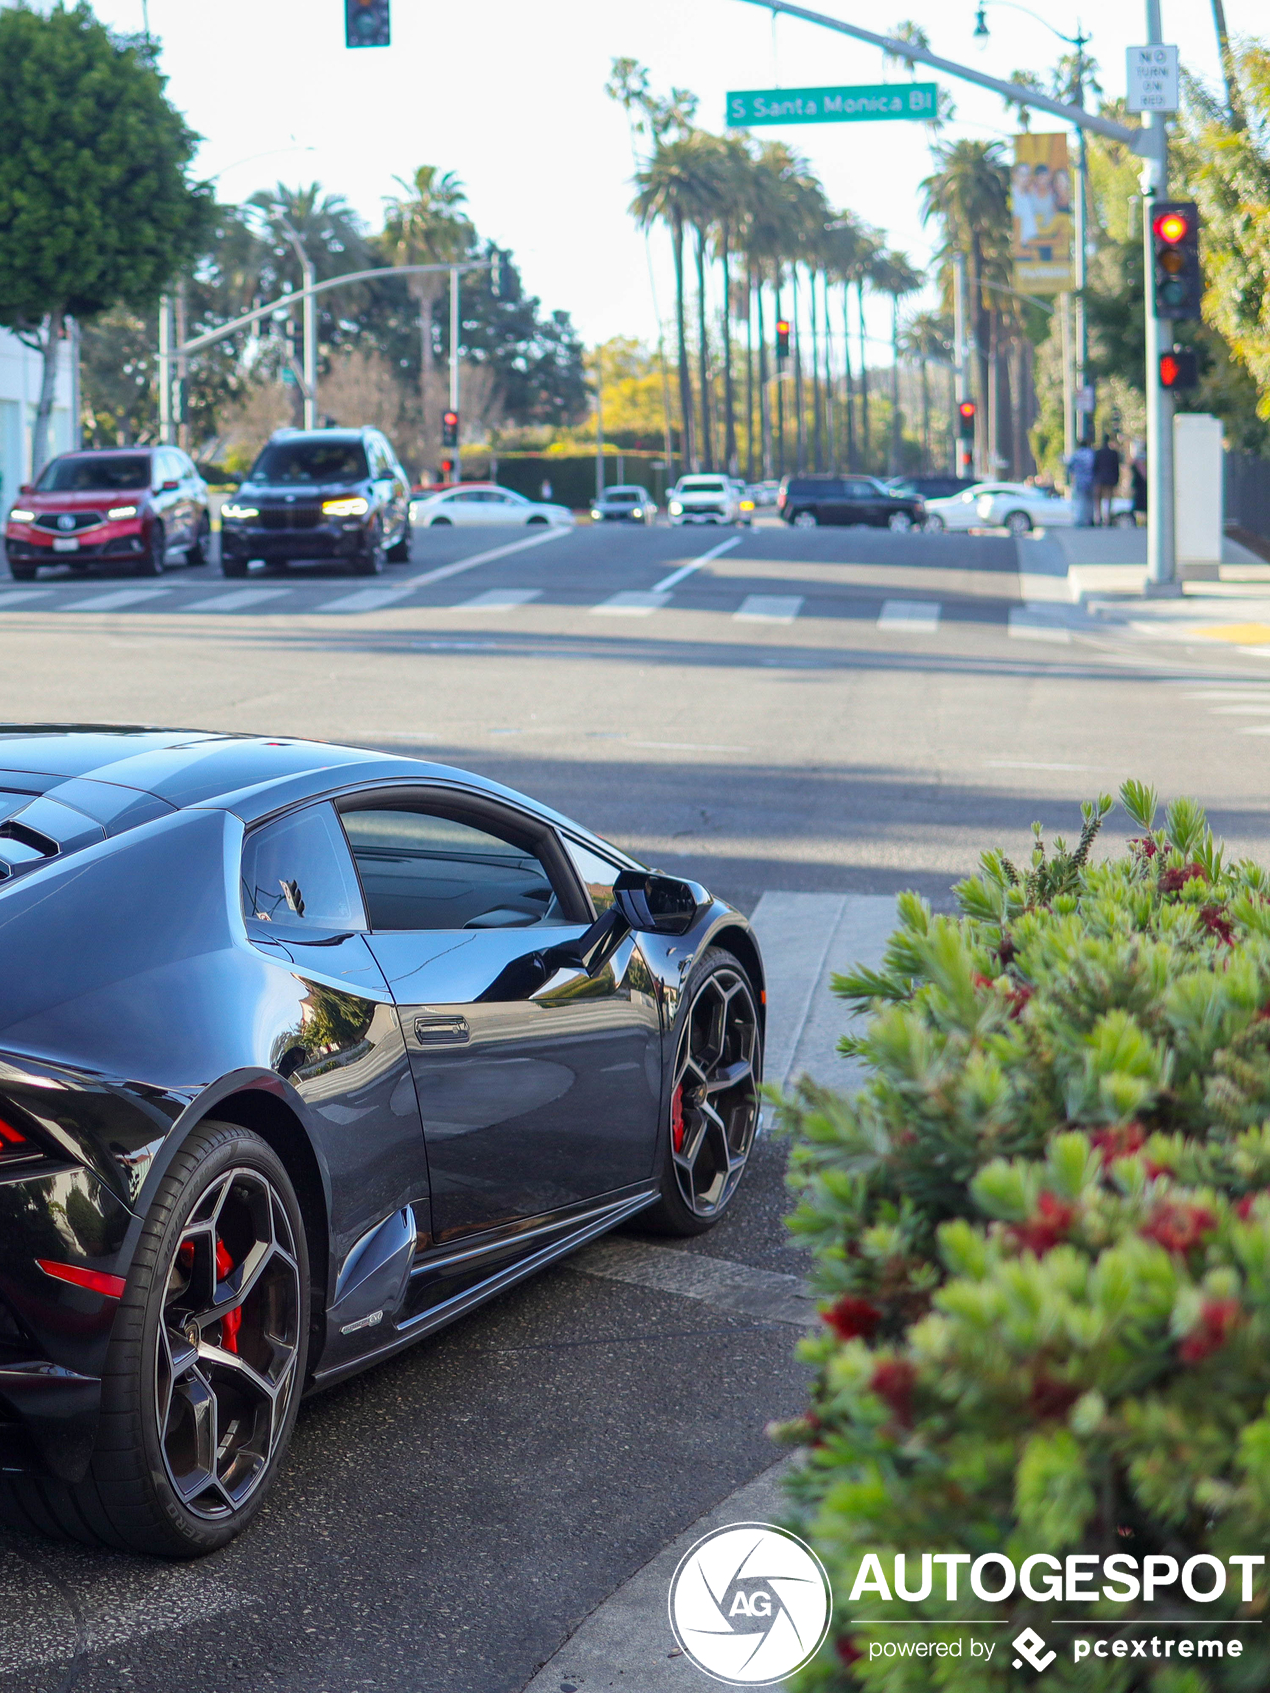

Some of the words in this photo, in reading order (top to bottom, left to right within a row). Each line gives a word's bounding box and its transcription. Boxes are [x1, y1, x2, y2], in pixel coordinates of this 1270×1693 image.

[1139, 49, 1167, 64] NO
[1136, 66, 1169, 78] TURN
[1143, 80, 1163, 93] ON
[731, 99, 747, 119] S
[753, 97, 818, 117] Santa
[823, 94, 903, 114] Monica
[1140, 94, 1165, 107] RED
[165, 1502, 206, 1544] ZERO
